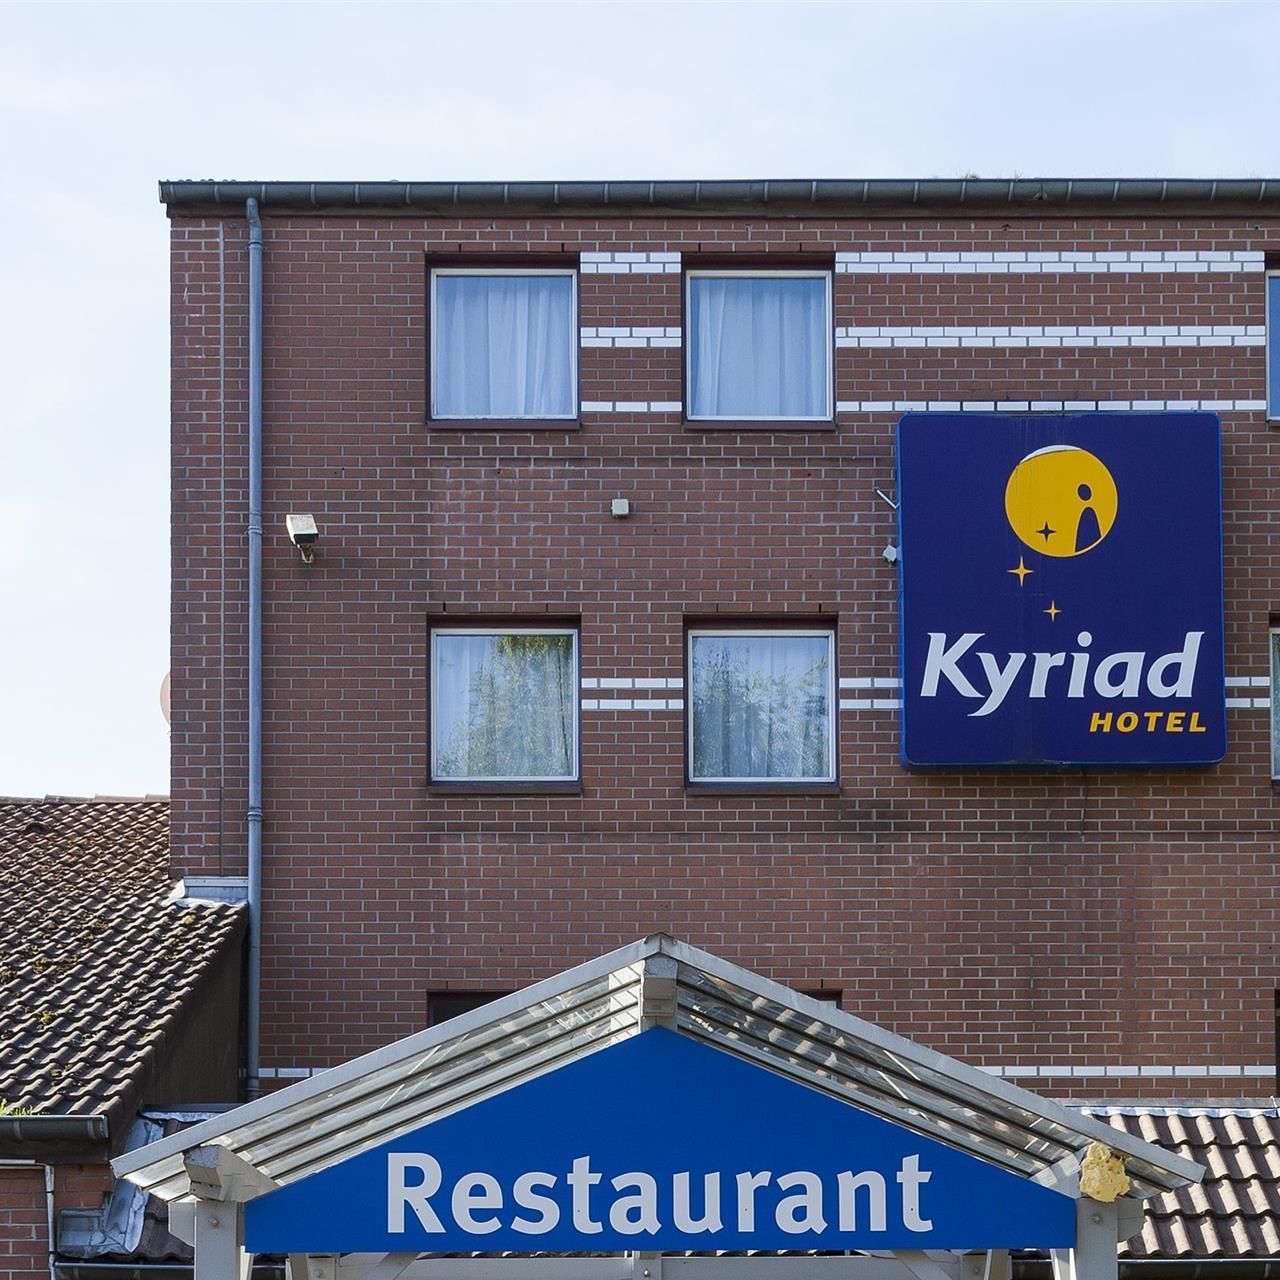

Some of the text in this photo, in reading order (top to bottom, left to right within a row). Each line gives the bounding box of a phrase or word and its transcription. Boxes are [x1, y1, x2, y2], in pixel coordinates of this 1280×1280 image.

[920, 631, 1205, 717] Kyriad
[1089, 711, 1208, 733] HOTEL
[386, 1152, 933, 1236] Restaurant
